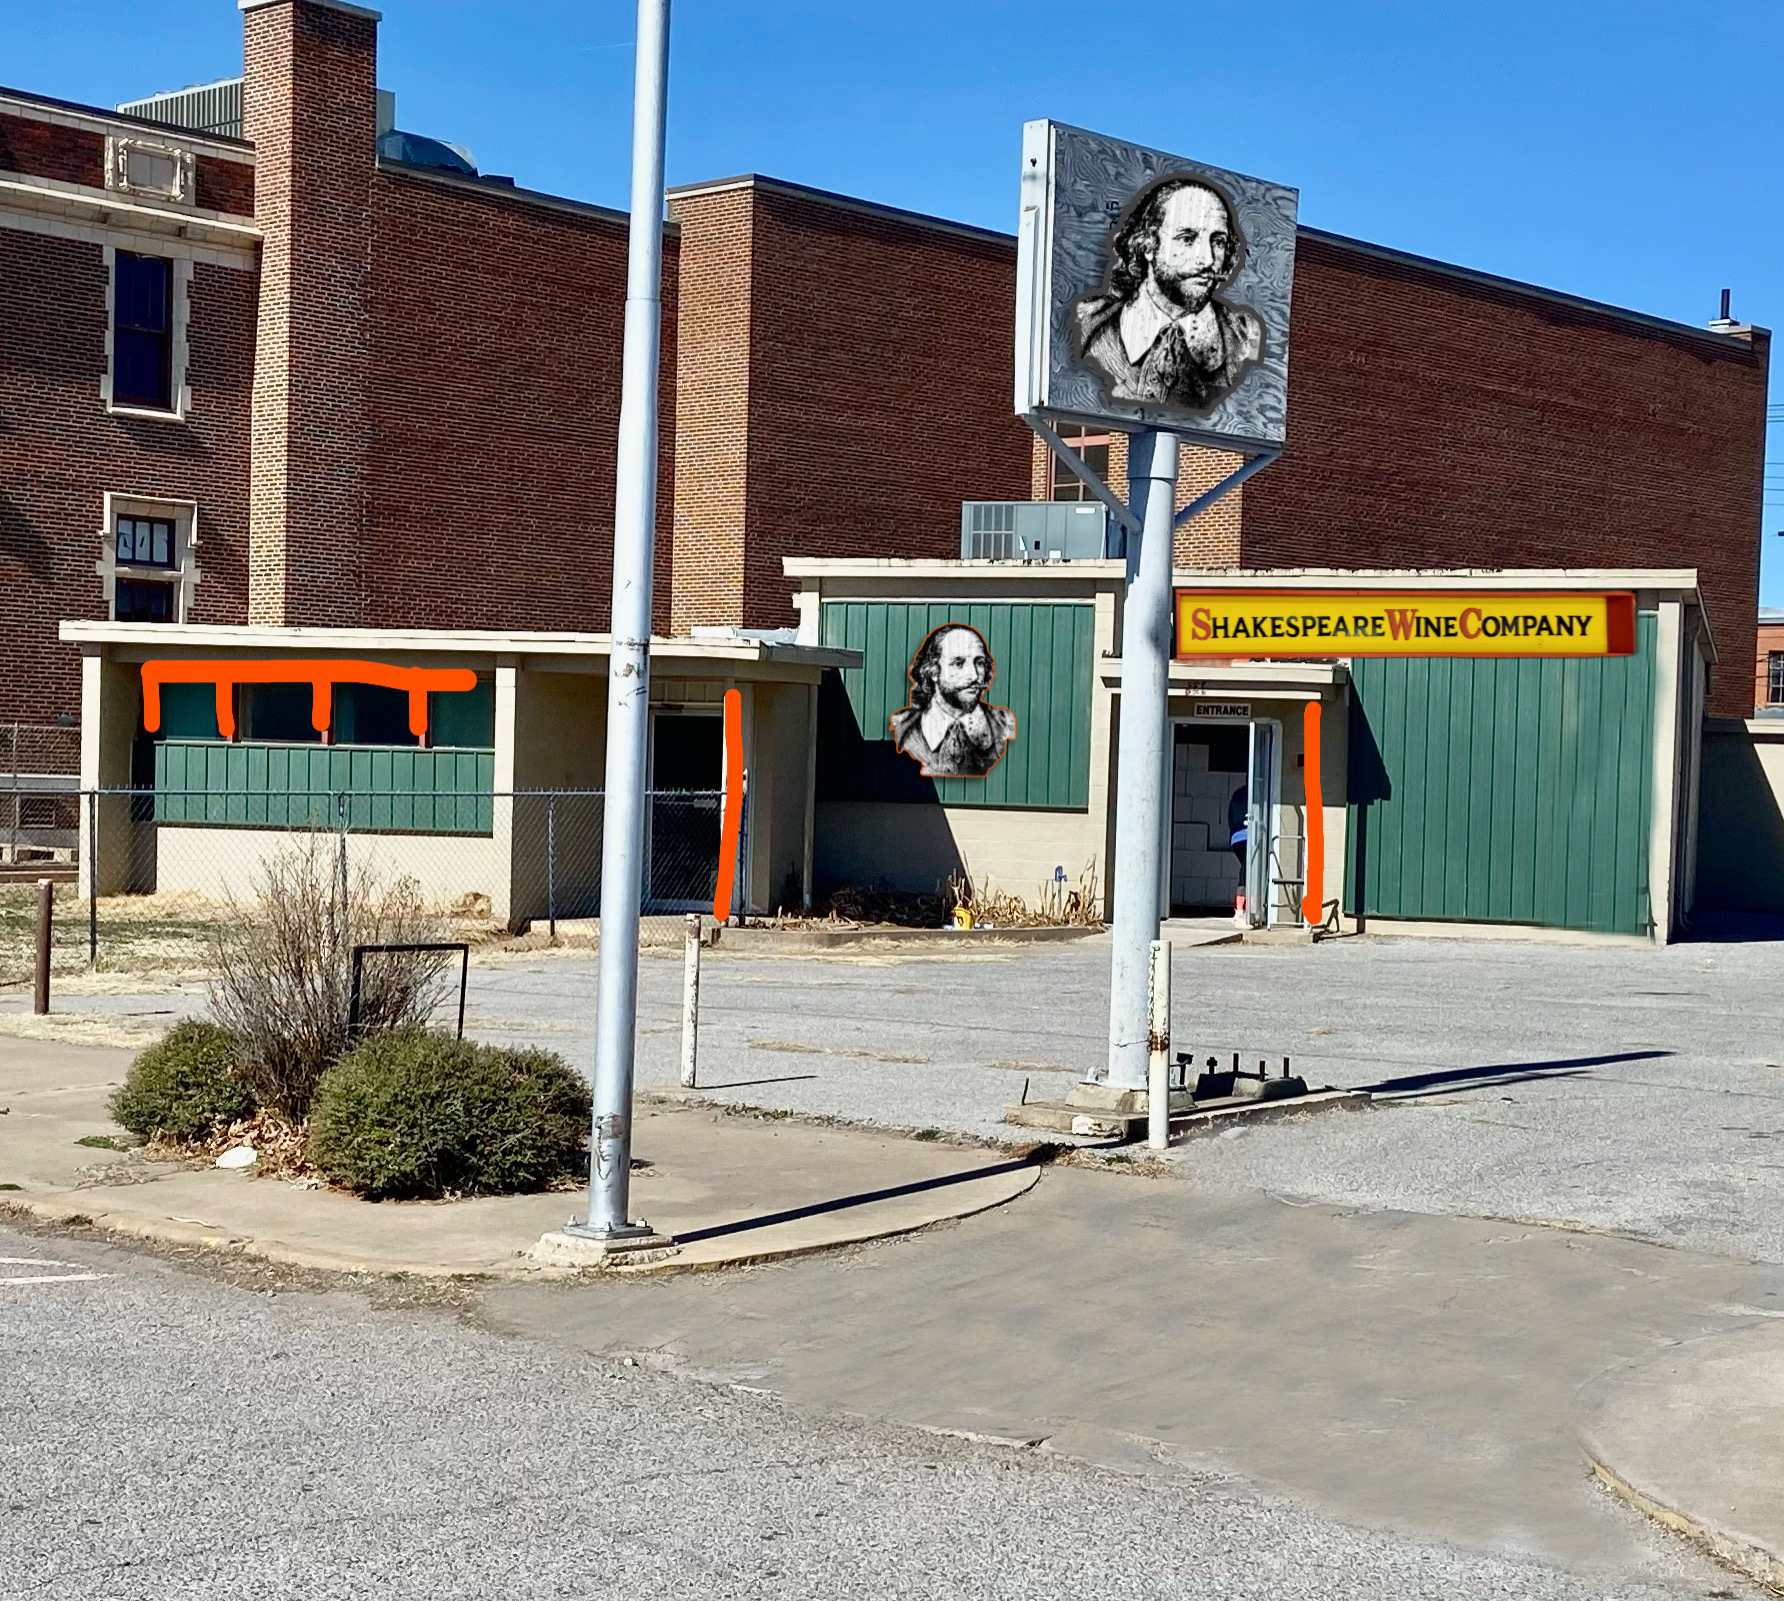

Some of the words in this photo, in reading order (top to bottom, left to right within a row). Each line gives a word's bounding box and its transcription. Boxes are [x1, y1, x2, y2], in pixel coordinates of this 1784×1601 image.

[1191, 607, 1386, 640] SHAKESPEARE
[1384, 608, 1458, 641] WINE
[1459, 607, 1593, 639] COMPANY
[1195, 704, 1250, 716] ENTRANCE
